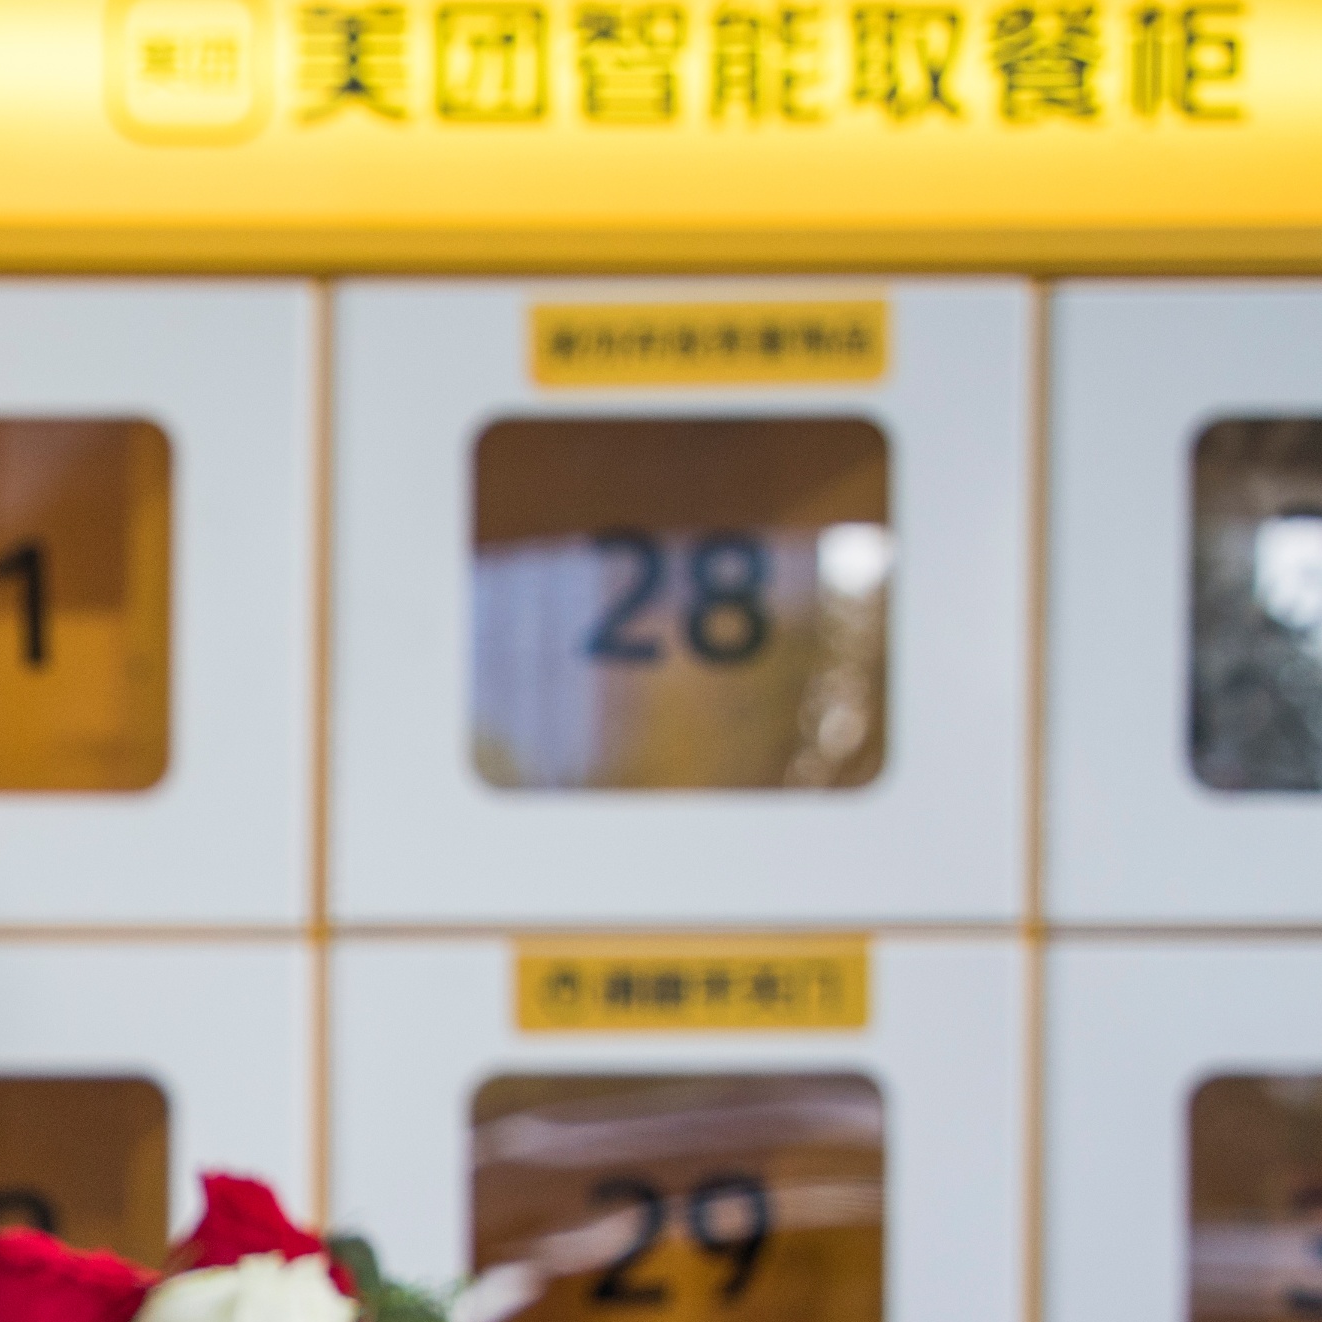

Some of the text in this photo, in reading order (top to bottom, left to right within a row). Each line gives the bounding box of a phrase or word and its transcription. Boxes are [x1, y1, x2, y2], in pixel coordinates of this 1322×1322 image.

[295, 2, 1245, 125] 美团智能取餐柜
[581, 525, 776, 668] 28
[589, 1168, 775, 1310] 29
